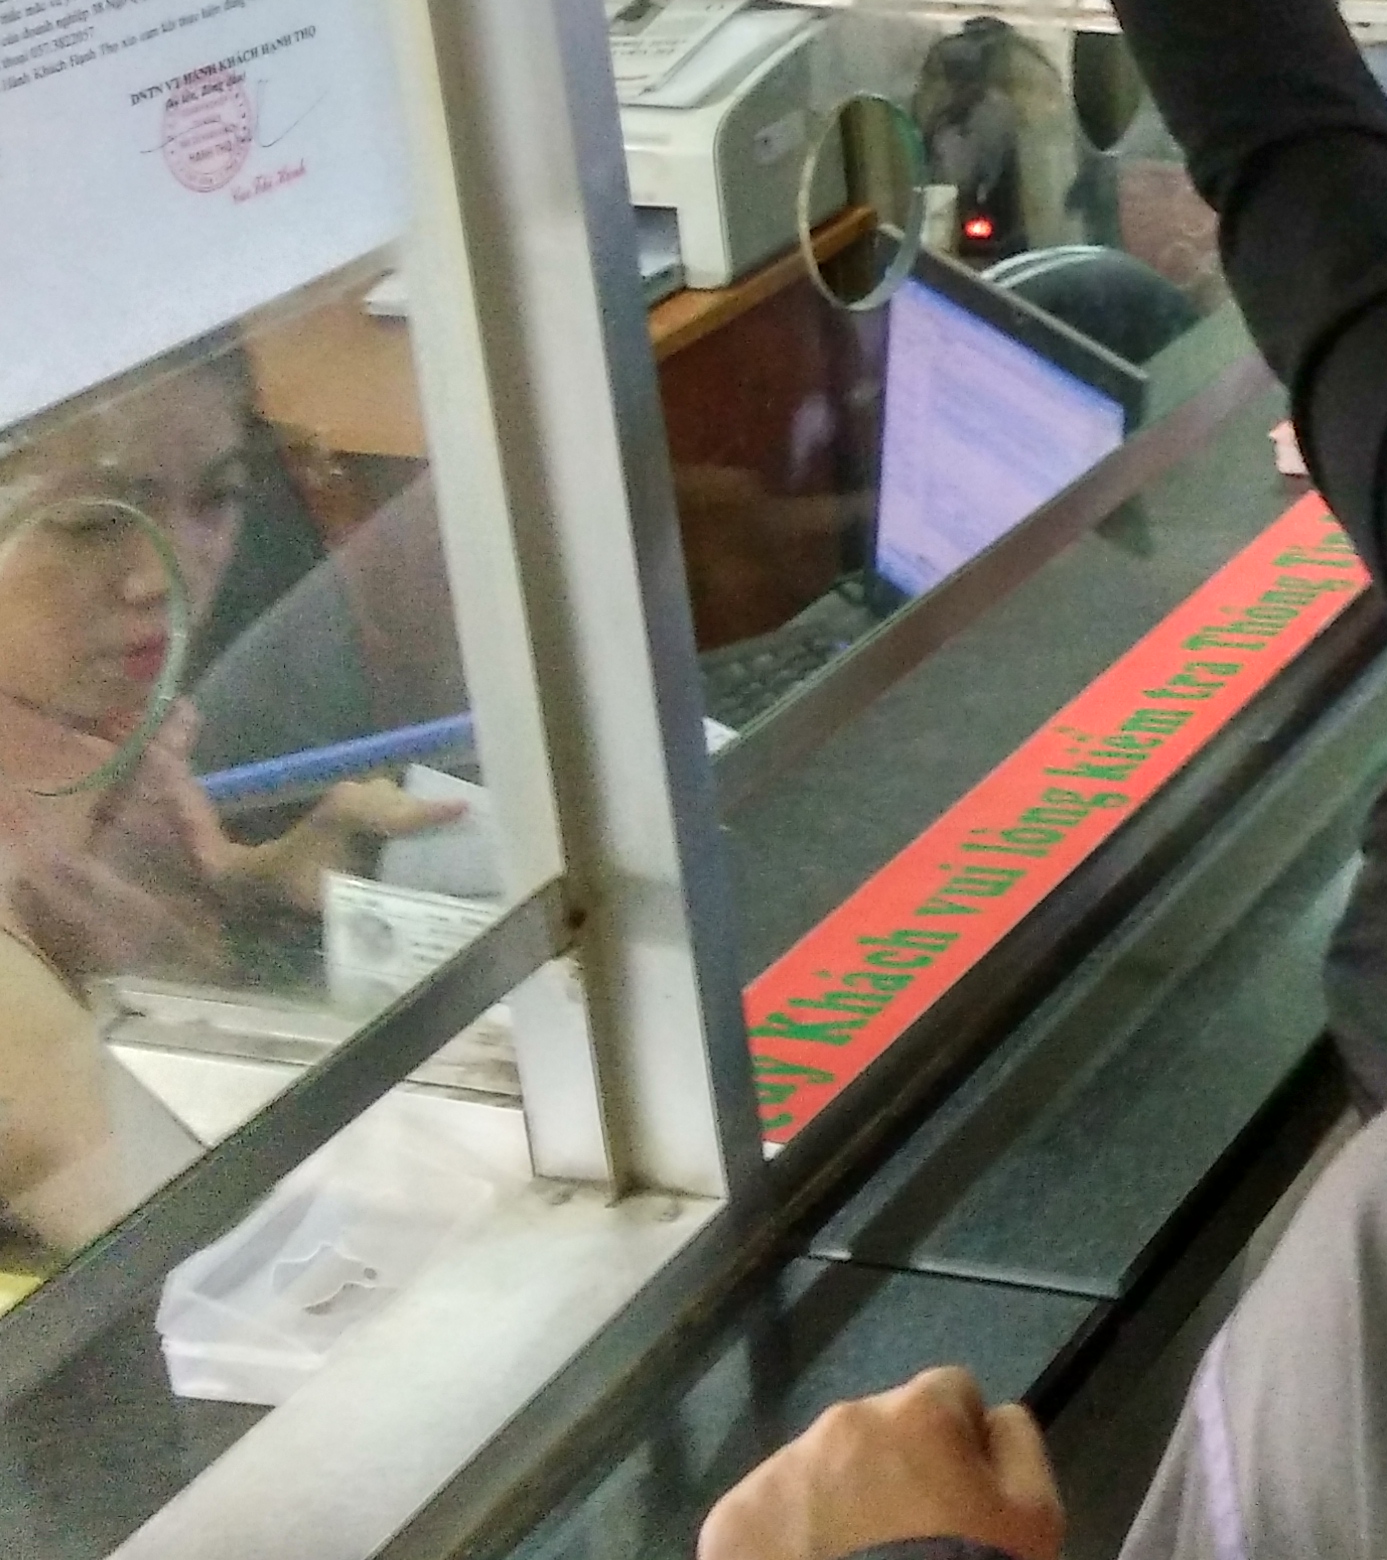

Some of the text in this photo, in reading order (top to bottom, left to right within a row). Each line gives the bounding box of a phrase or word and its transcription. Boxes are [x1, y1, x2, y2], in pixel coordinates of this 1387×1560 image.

[1180, 574, 1355, 652] Thông
[1142, 661, 1245, 701] tra
[1043, 706, 1197, 782] kiểm
[960, 786, 1130, 859] lòng
[913, 862, 1030, 920] vui
[748, 929, 961, 1047] Khách
